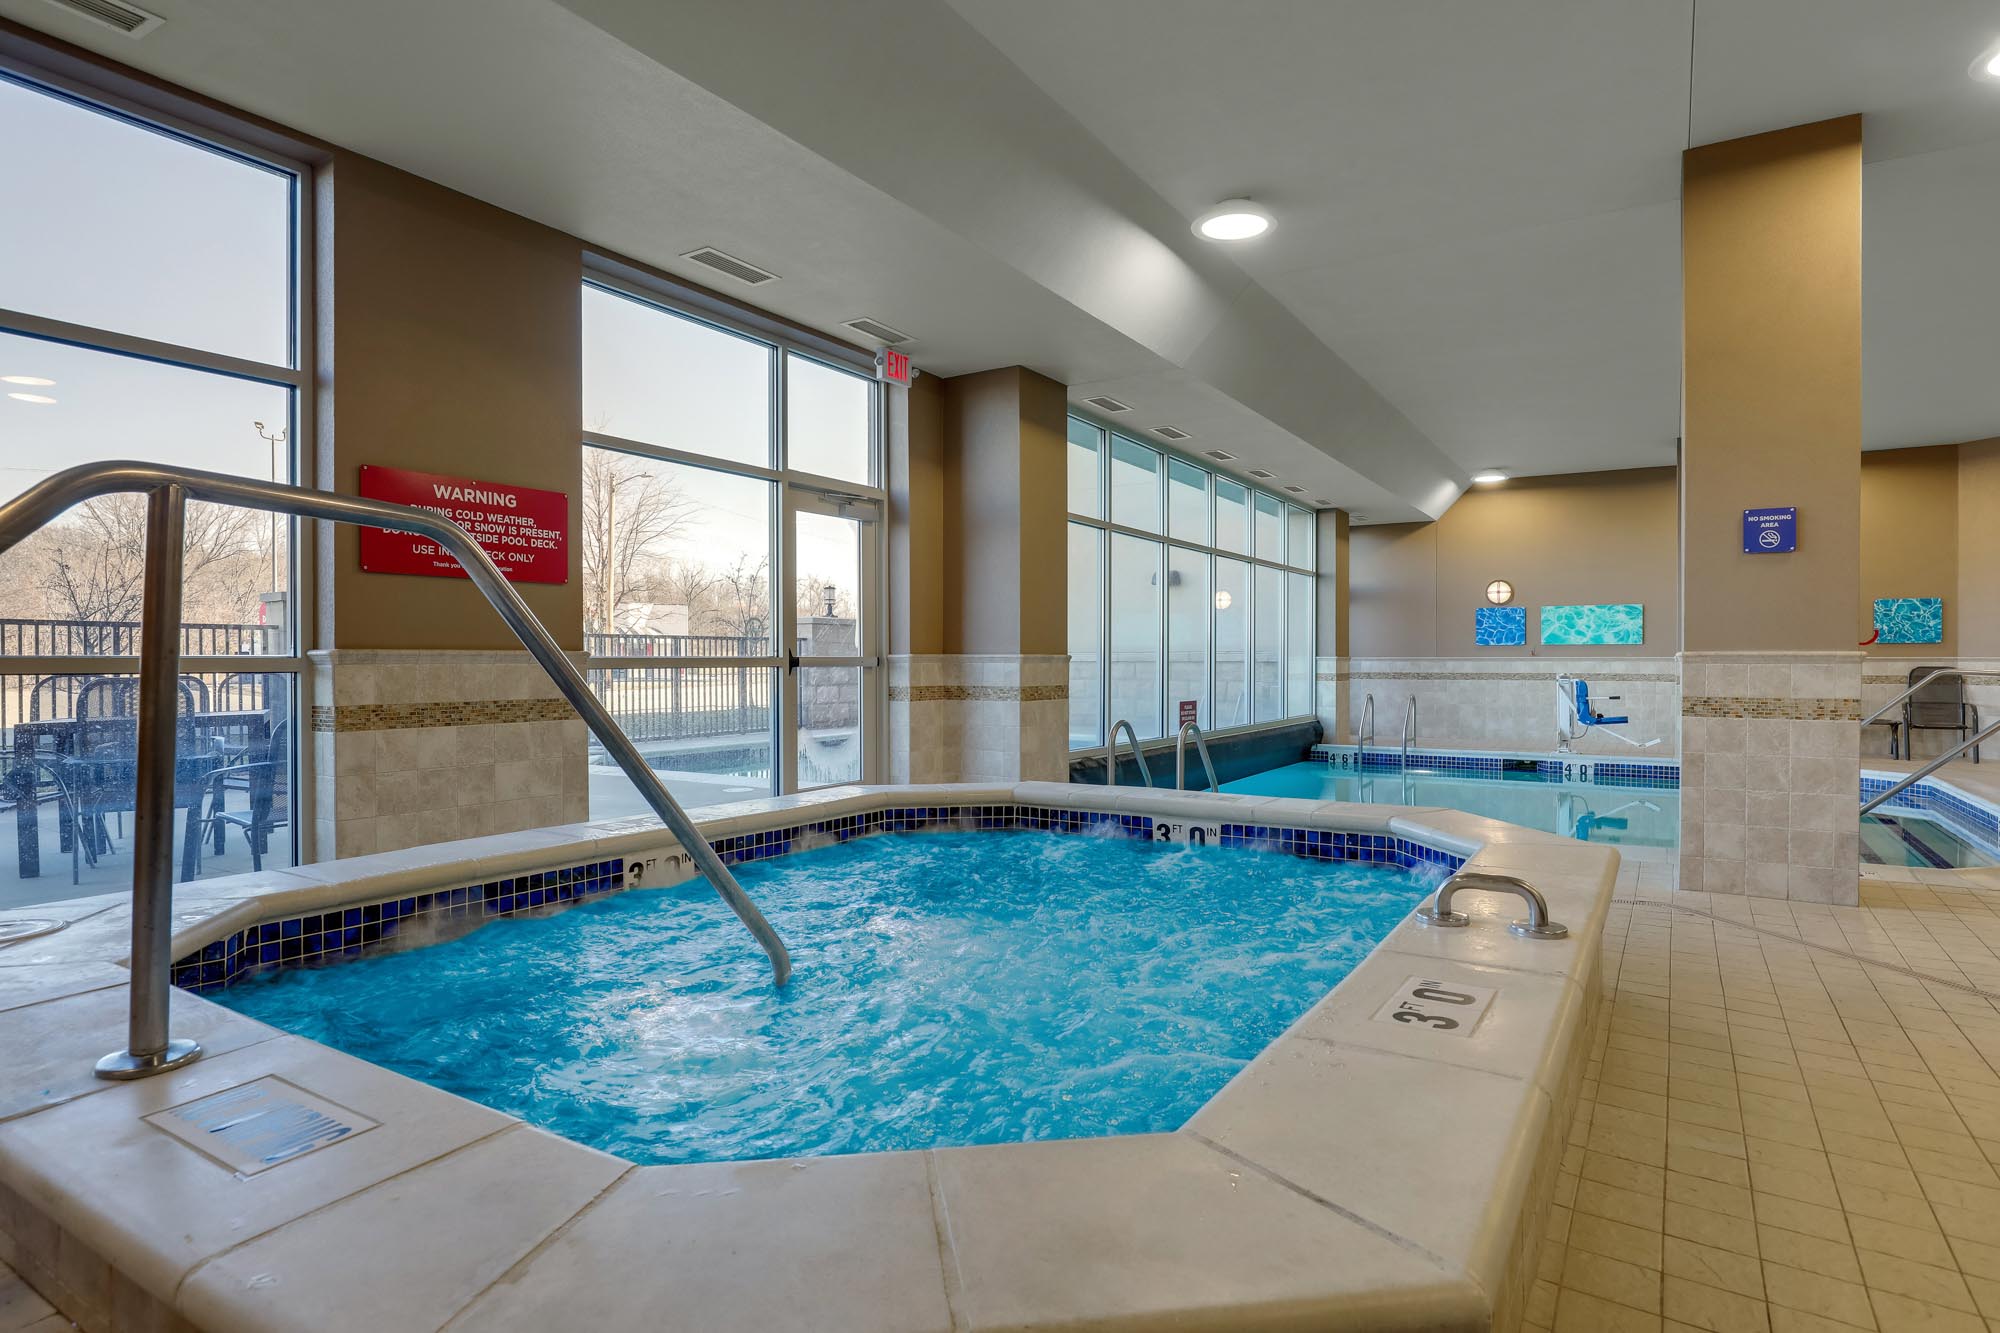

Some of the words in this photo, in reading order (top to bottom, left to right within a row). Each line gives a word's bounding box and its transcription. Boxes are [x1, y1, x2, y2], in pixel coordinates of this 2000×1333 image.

[887, 350, 909, 382] EXIT
[433, 484, 517, 508] WARNING
[410, 504, 453, 518] ING
[456, 509, 484, 521] COLD
[486, 512, 537, 528] WEATHER,
[457, 520, 472, 531] OR
[474, 522, 505, 534] SNOW
[508, 526, 518, 535] IS
[520, 527, 562, 541] PRESENT,
[470, 532, 499, 544] TSIDE
[501, 536, 528, 547] POOL
[530, 540, 558, 549] DECK.
[412, 544, 435, 555] USE
[486, 551, 506, 561] ECK
[508, 553, 535, 563] ONLY
[1330, 753, 1336, 762] 4
[1342, 754, 1349, 763] 6
[1565, 764, 1572, 775] 4
[1156, 823, 1171, 842] 3
[1172, 824, 1182, 833] FT
[1189, 826, 1206, 847] 0
[1206, 828, 1217, 837] IN
[628, 862, 644, 887] 3
[646, 859, 657, 871] FT
[681, 853, 692, 864] IN
[1412, 988, 1476, 1005] 0
[1400, 1001, 1424, 1012] FT
[1392, 1011, 1459, 1030] 3
